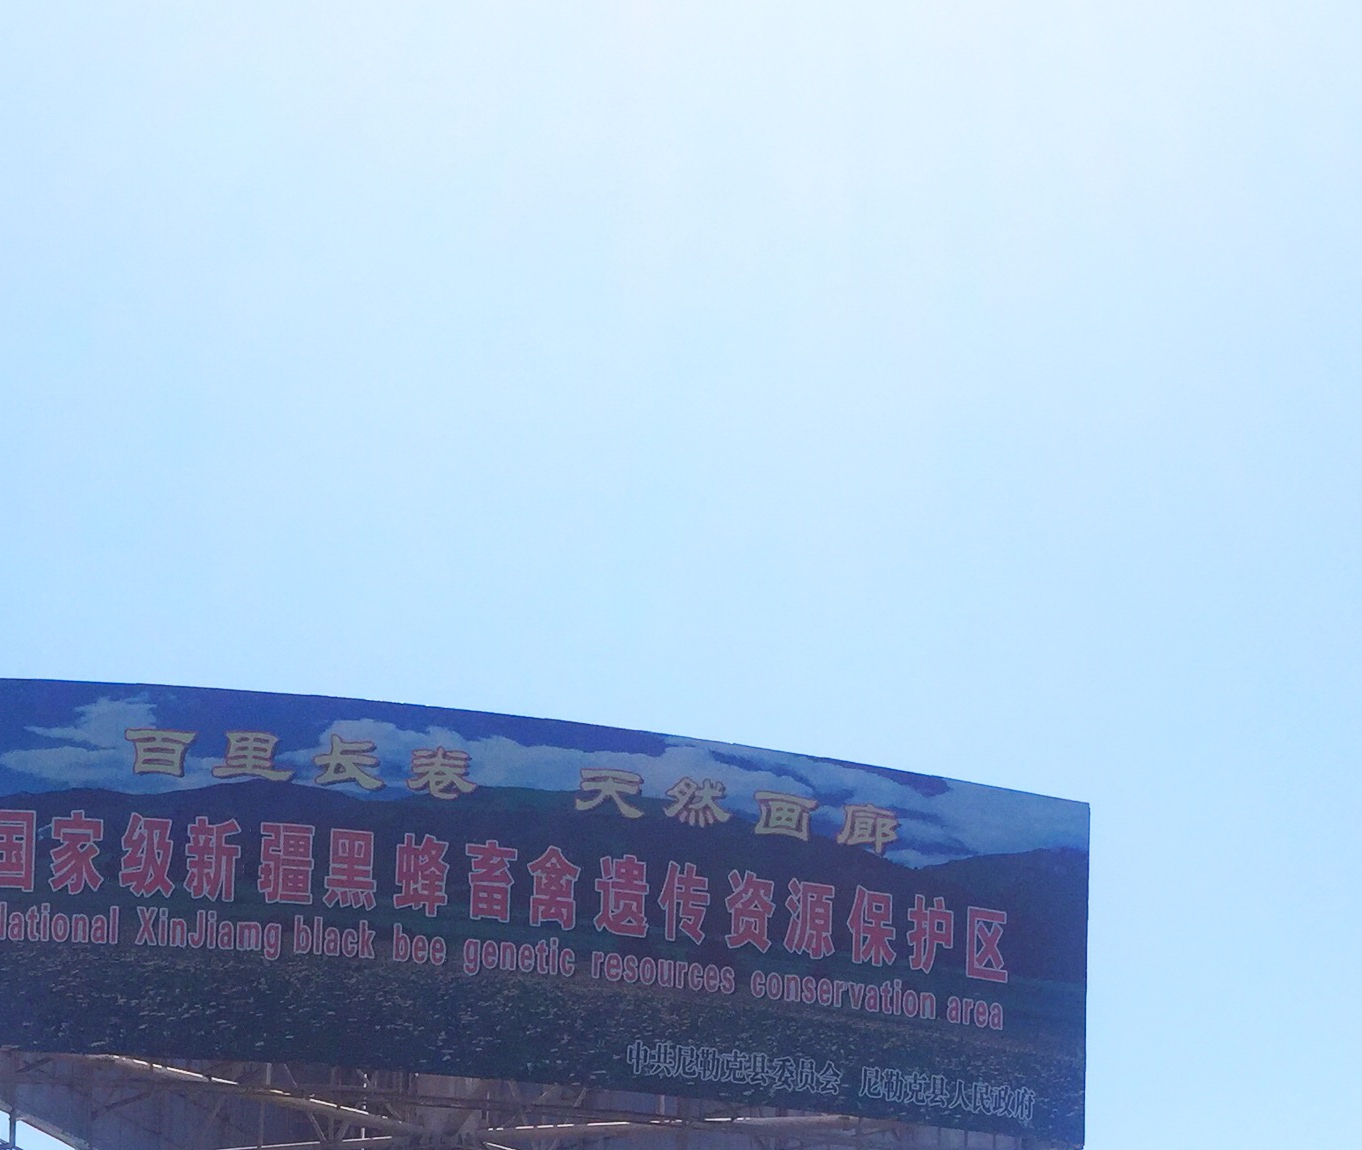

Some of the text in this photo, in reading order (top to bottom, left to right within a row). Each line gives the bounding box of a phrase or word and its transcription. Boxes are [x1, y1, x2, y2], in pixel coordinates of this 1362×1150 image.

[124, 727, 901, 855] 百里长卷 天然画廊
[293, 915, 376, 960] black
[392, 923, 447, 966] bee
[463, 937, 576, 976] genetic
[591, 951, 736, 994] resources
[750, 970, 936, 1020] conservation
[946, 995, 1004, 1030] area
[627, 1040, 1036, 1120] 中共尼勒克县委员会 尼勒克县人民政府
